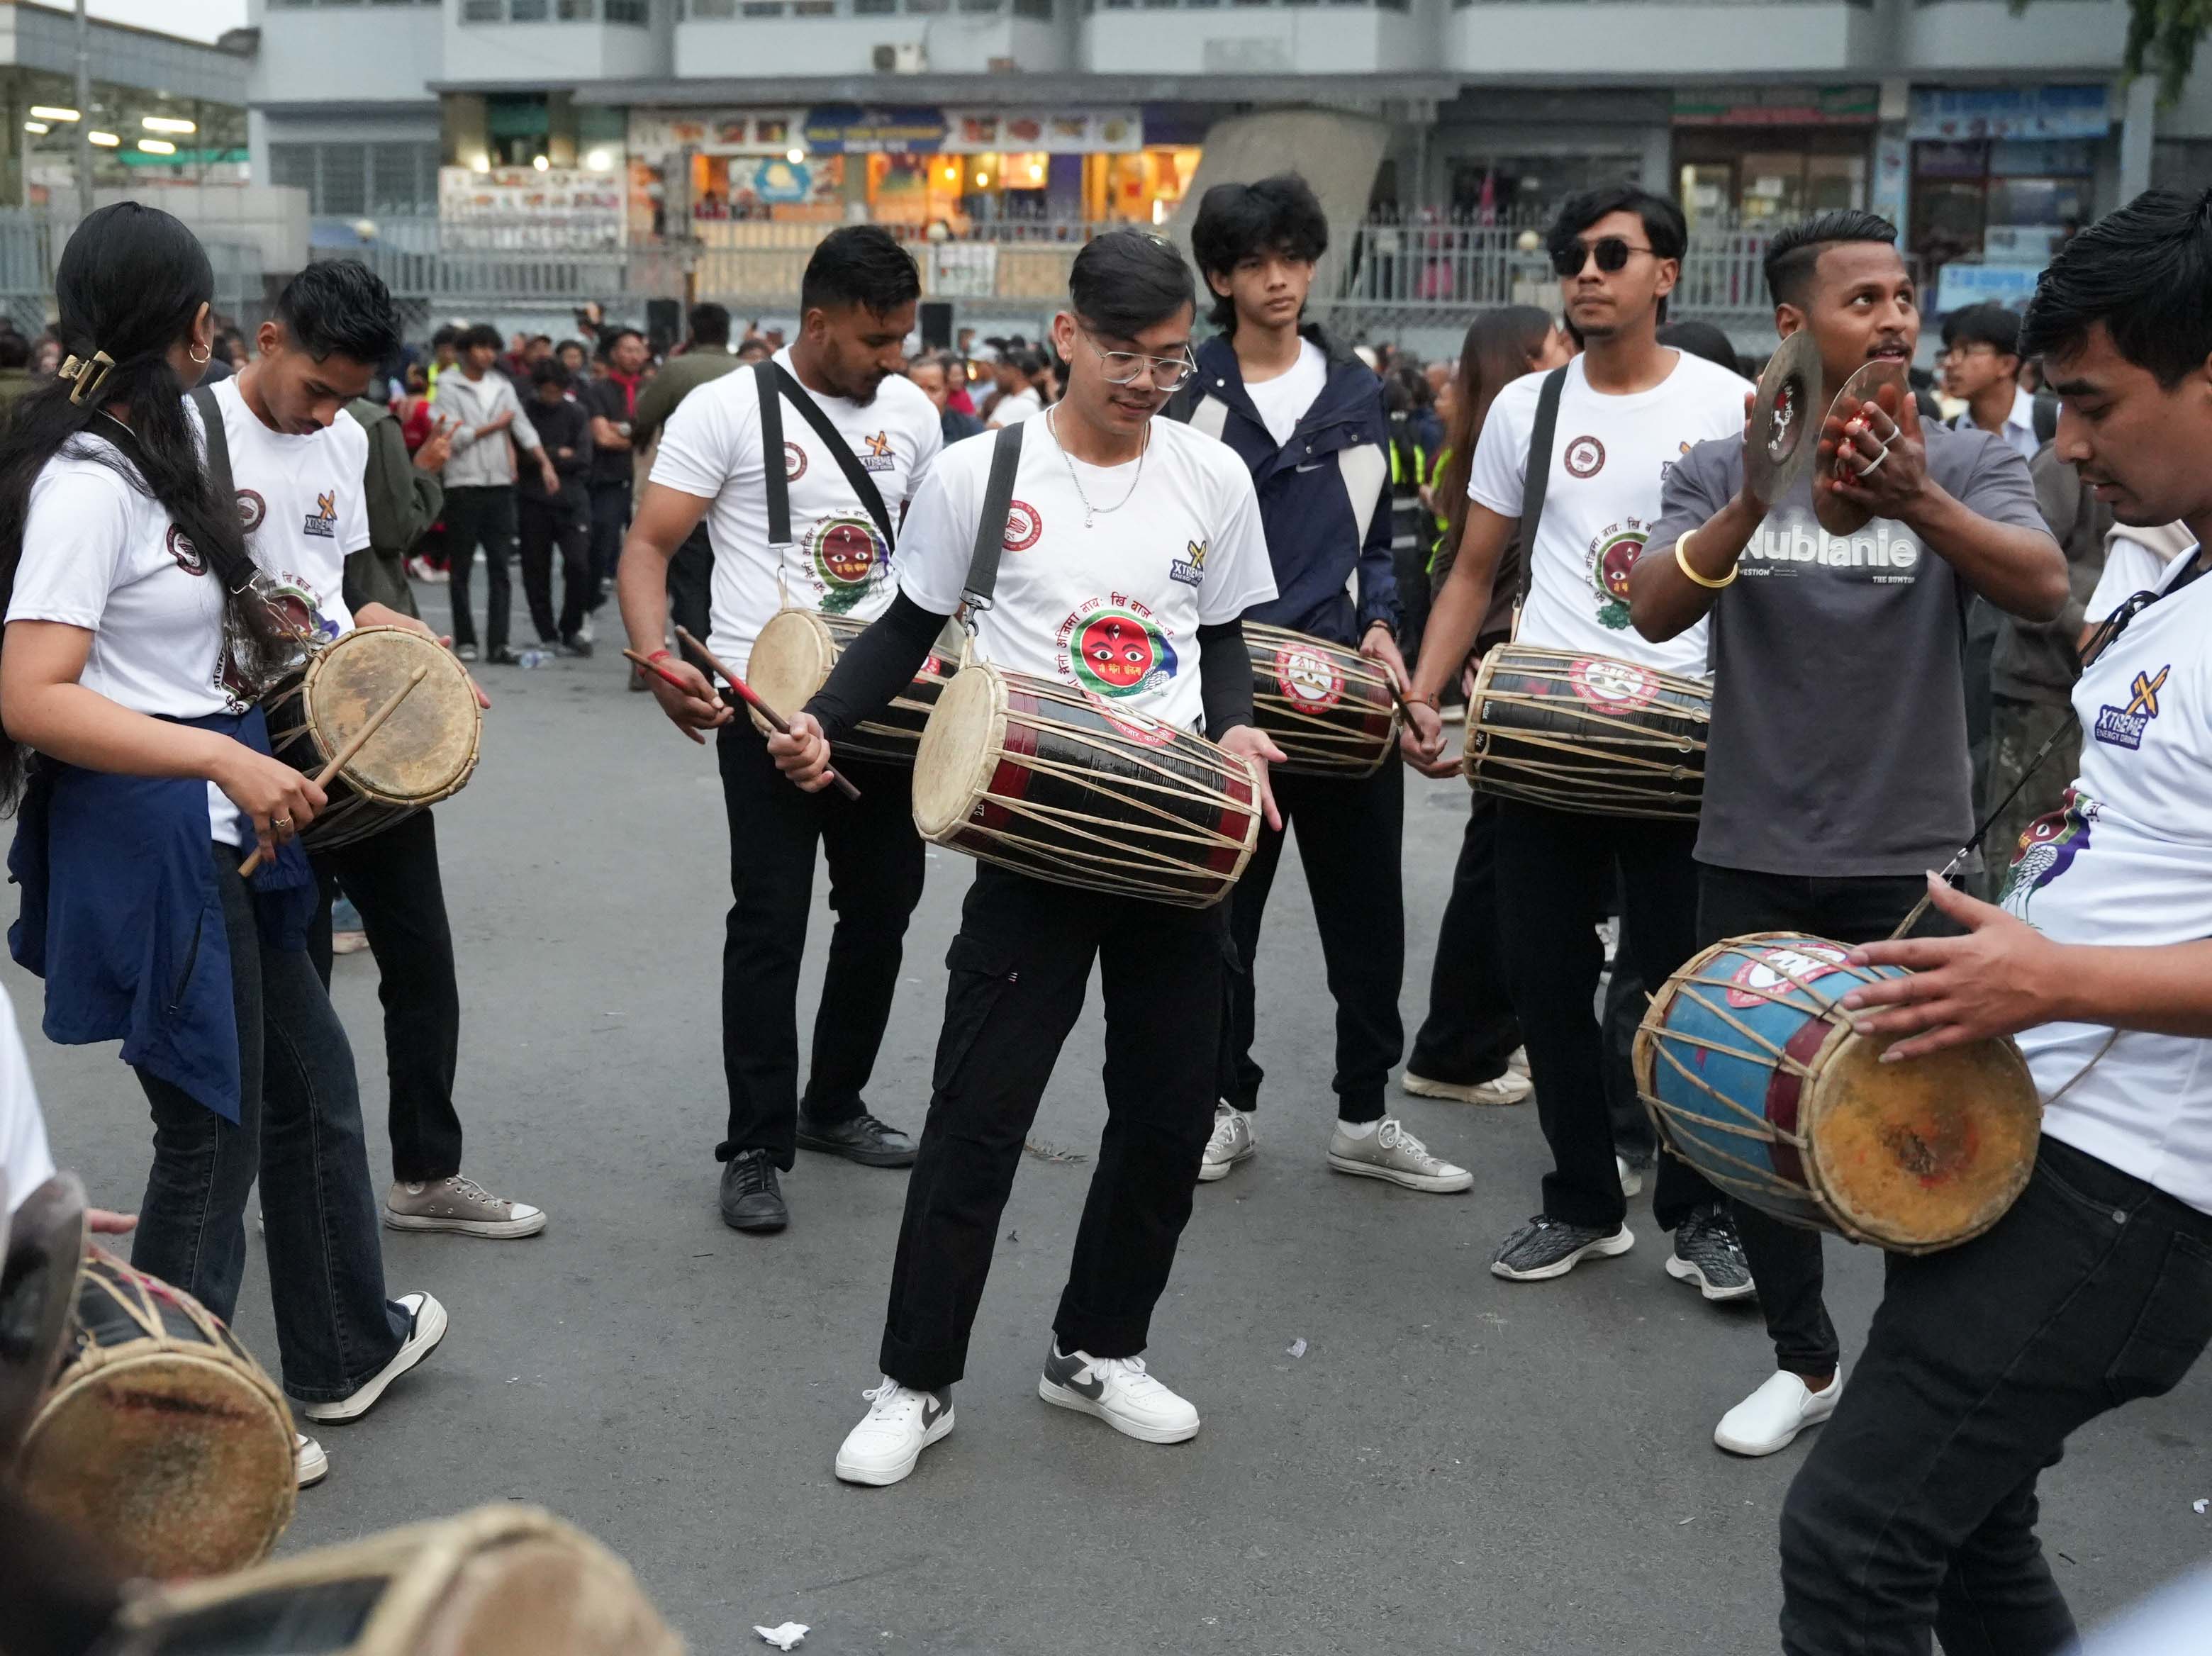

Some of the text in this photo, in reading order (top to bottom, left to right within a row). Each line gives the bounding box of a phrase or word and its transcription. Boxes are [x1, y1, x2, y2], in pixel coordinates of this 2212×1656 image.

[1055, 612, 1080, 649] अजिमा
[2096, 728, 2119, 741] ENERGY
[2099, 709, 2147, 736] XTREME
